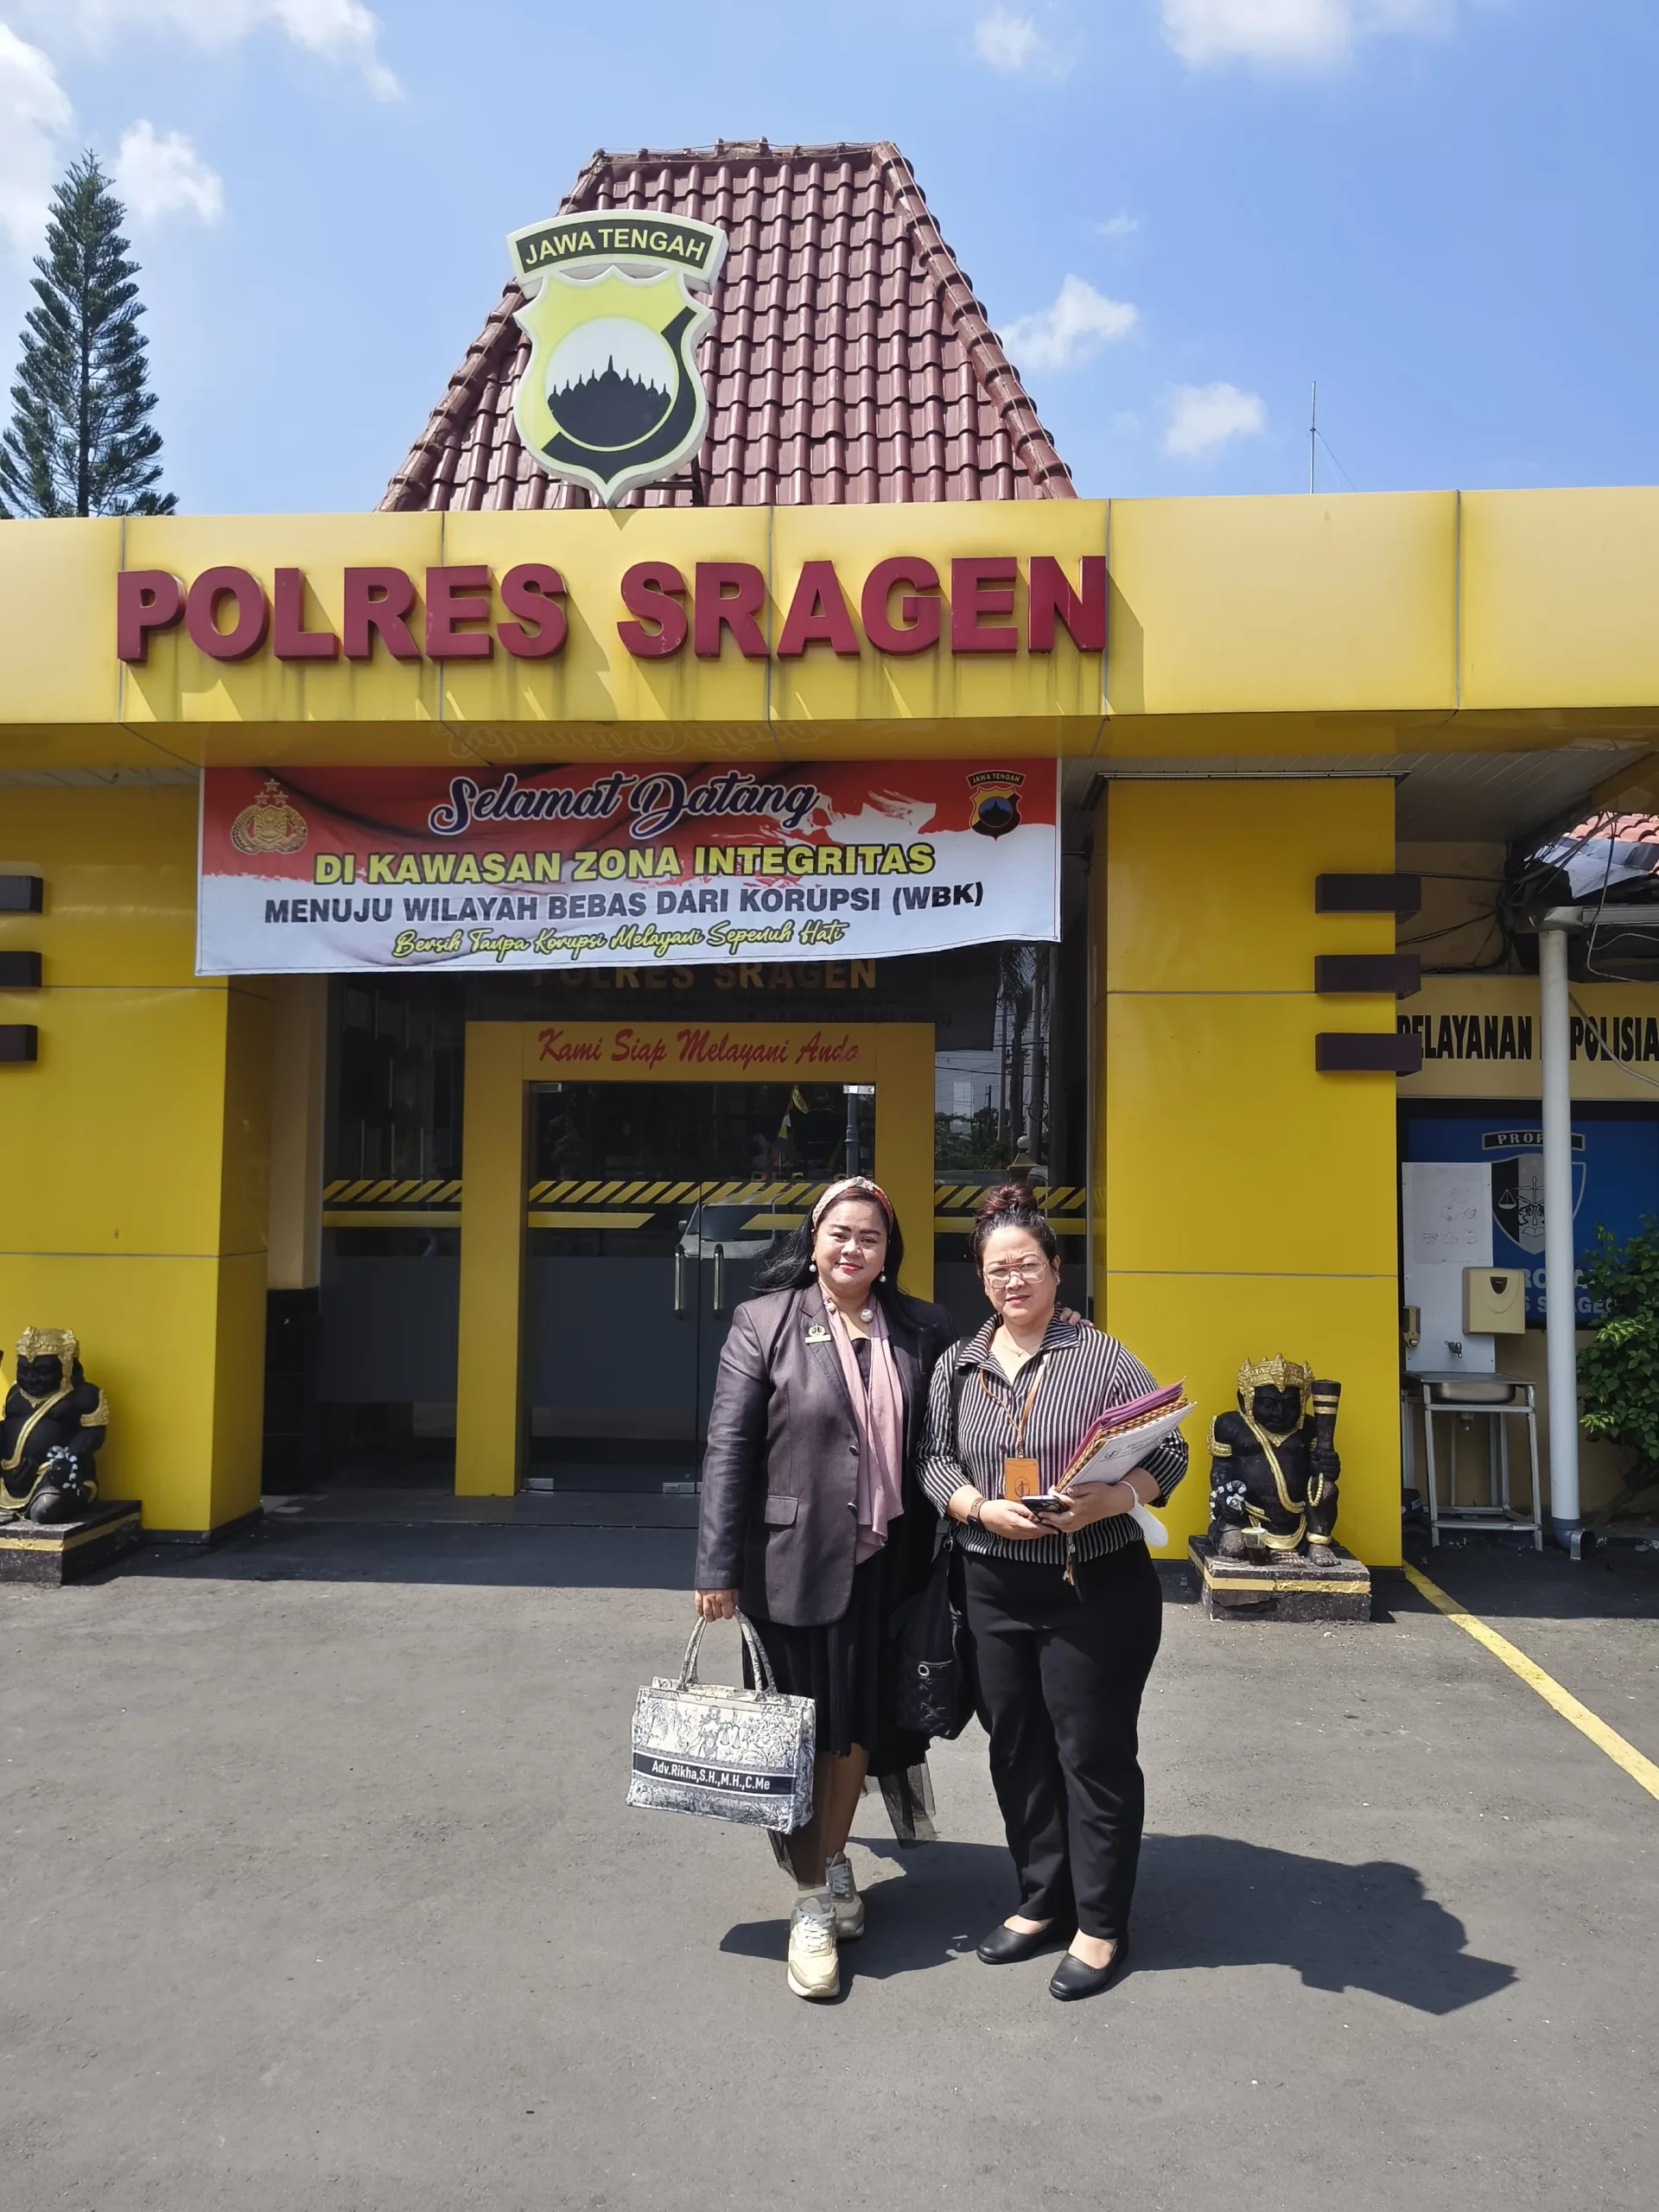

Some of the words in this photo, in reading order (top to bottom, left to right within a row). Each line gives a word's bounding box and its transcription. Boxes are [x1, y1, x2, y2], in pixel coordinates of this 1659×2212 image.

[524, 230, 595, 265] JAWA
[598, 228, 706, 261] TENGAH
[118, 563, 569, 664] POLRES
[617, 555, 1107, 660] SRAGEN
[972, 773, 991, 783] JAWA
[992, 772, 1020, 783] TENGAH
[429, 771, 637, 836] Selamat
[629, 770, 824, 839] Datang
[314, 854, 355, 885] DI
[366, 849, 560, 884] KAWASAN
[572, 846, 683, 880] ZONA
[693, 842, 936, 877] INTEGRITAS
[264, 898, 393, 924] MENUJU
[404, 895, 537, 922] WILAYAH
[548, 892, 647, 920] BEBAS
[656, 888, 728, 915] DARI
[739, 887, 880, 913] KORUPSI
[892, 881, 983, 915] (WBK)
[392, 929, 463, 957] Bersih
[534, 927, 607, 961] Korupsi
[609, 923, 704, 957] Melayani
[706, 919, 795, 955] Sepenuh
[799, 919, 849, 944] Hati
[714, 958, 876, 989] SRAGEN
[537, 1028, 601, 1063] Kami
[610, 1027, 668, 1071] Siap
[677, 1028, 789, 1071] Melayani
[795, 1030, 861, 1065] Anda
